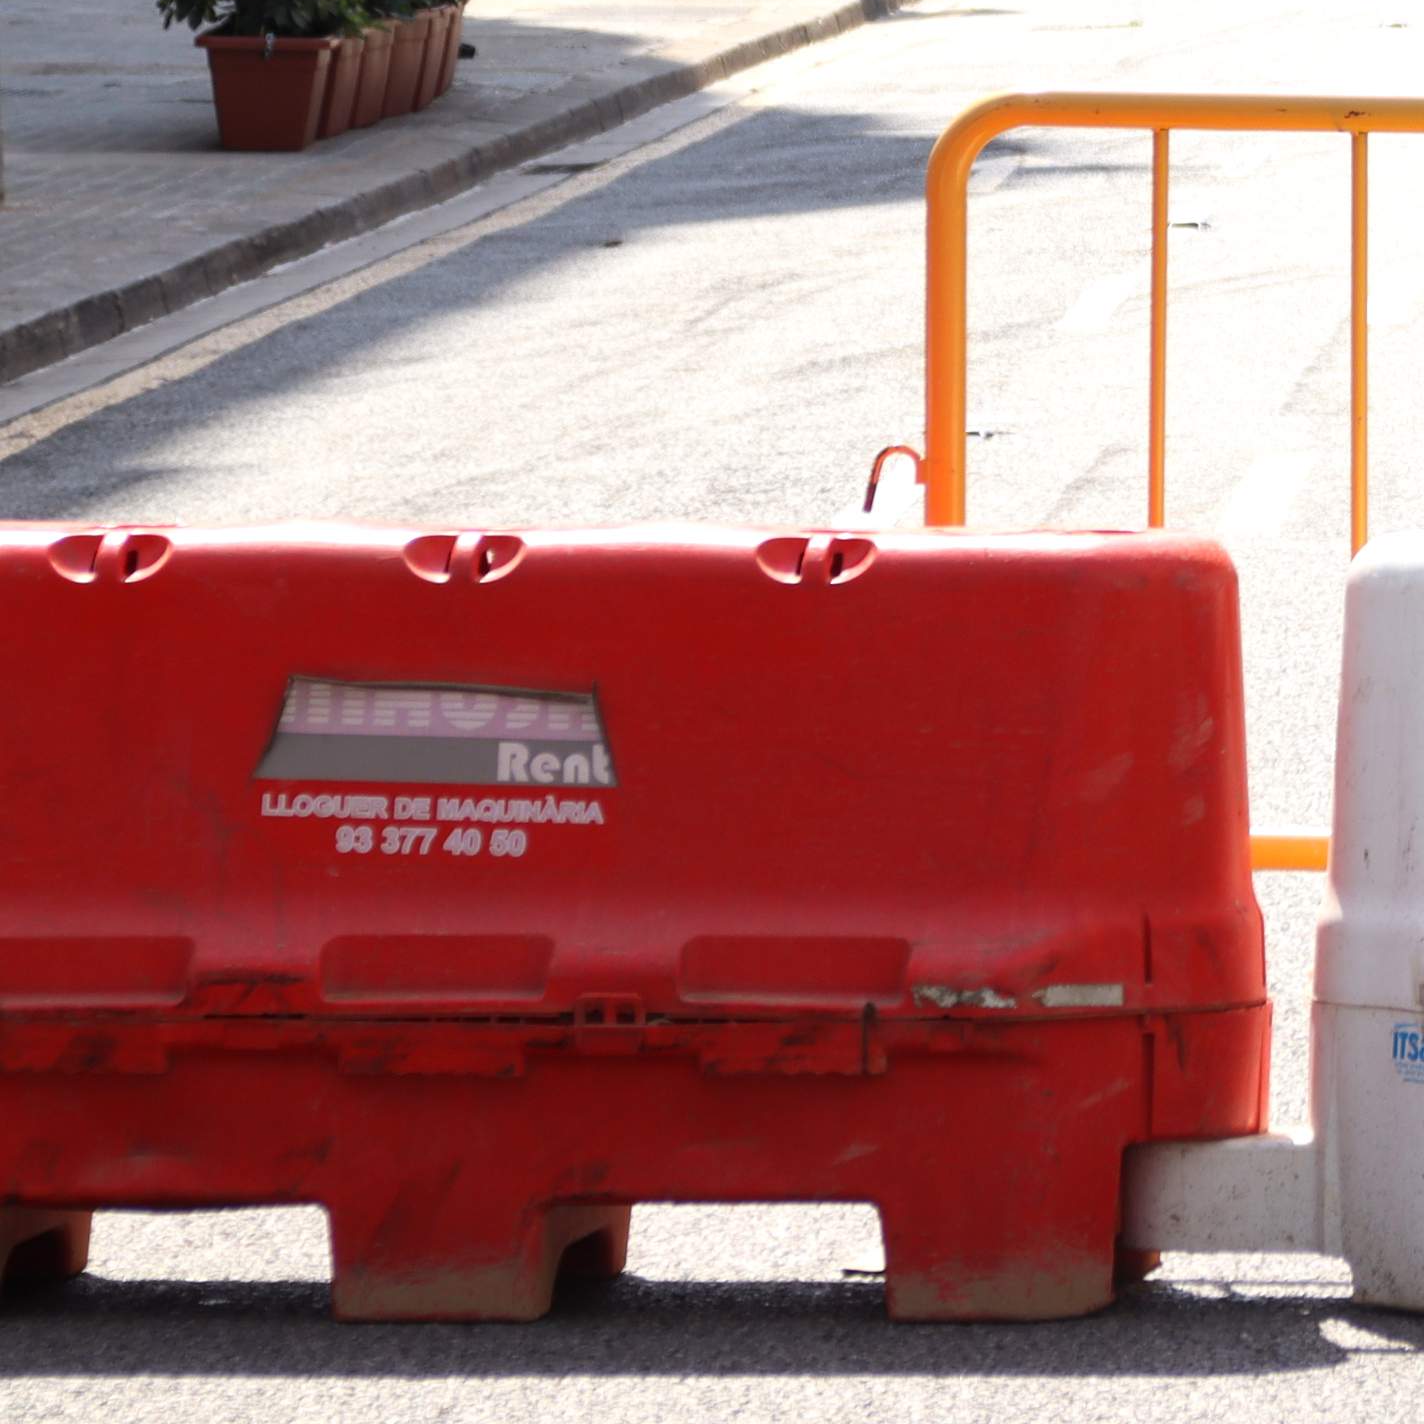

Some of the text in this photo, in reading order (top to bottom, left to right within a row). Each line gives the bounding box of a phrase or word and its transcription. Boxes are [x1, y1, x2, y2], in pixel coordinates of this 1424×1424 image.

[496, 741, 612, 784] Rent
[261, 794, 604, 825] LLOGUER DE MAQUINÀRIA
[335, 825, 527, 857] 93 377 40 50
